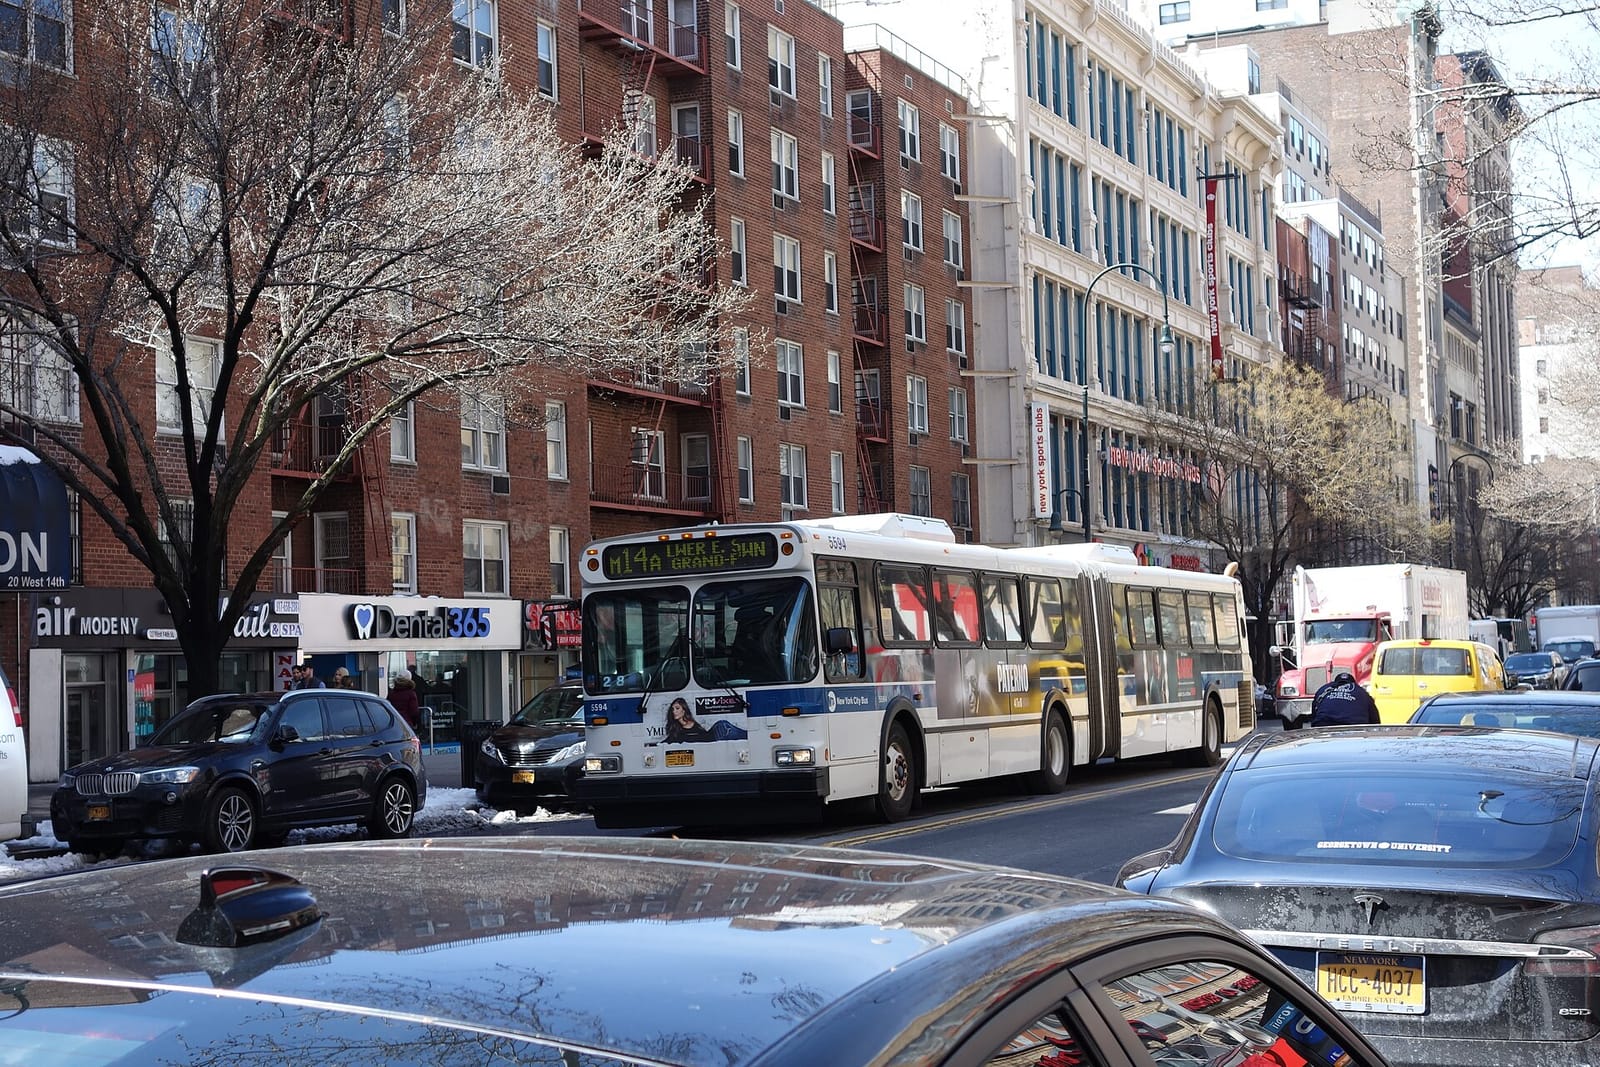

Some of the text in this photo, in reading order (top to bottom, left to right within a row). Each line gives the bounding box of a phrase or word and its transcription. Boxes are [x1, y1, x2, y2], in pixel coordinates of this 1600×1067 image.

[1207, 252, 1216, 287] sports
[1208, 288, 1218, 312] york
[1210, 314, 1218, 337] new
[1034, 407, 1048, 513] new york sports clubs
[1110, 446, 1128, 468] new
[1129, 448, 1150, 475] york
[1152, 456, 1178, 479] sports
[827, 535, 847, 551] 5594
[609, 546, 663, 576] M14A
[8, 576, 65, 588] 20 West 14th
[37, 596, 139, 636] air MODE NY
[220, 597, 270, 637] ail
[375, 604, 491, 639] Dental365
[271, 624, 303, 636] & SPA
[996, 663, 1030, 693] PATERNO
[590, 703, 608, 712] 5594
[836, 696, 845, 705] New
[845, 696, 853, 705] York
[861, 696, 869, 705] Bus
[0, 734, 16, 744] om
[646, 726, 664, 737] YMI
[1316, 841, 1452, 853] GEORGETOWN UNIVERSITY
[1316, 938, 1426, 953] TESLA
[1344, 955, 1398, 966] NEW YORK
[1343, 995, 1398, 1004] EMPIRE STATE
[1344, 1002, 1415, 1013] ESLA
